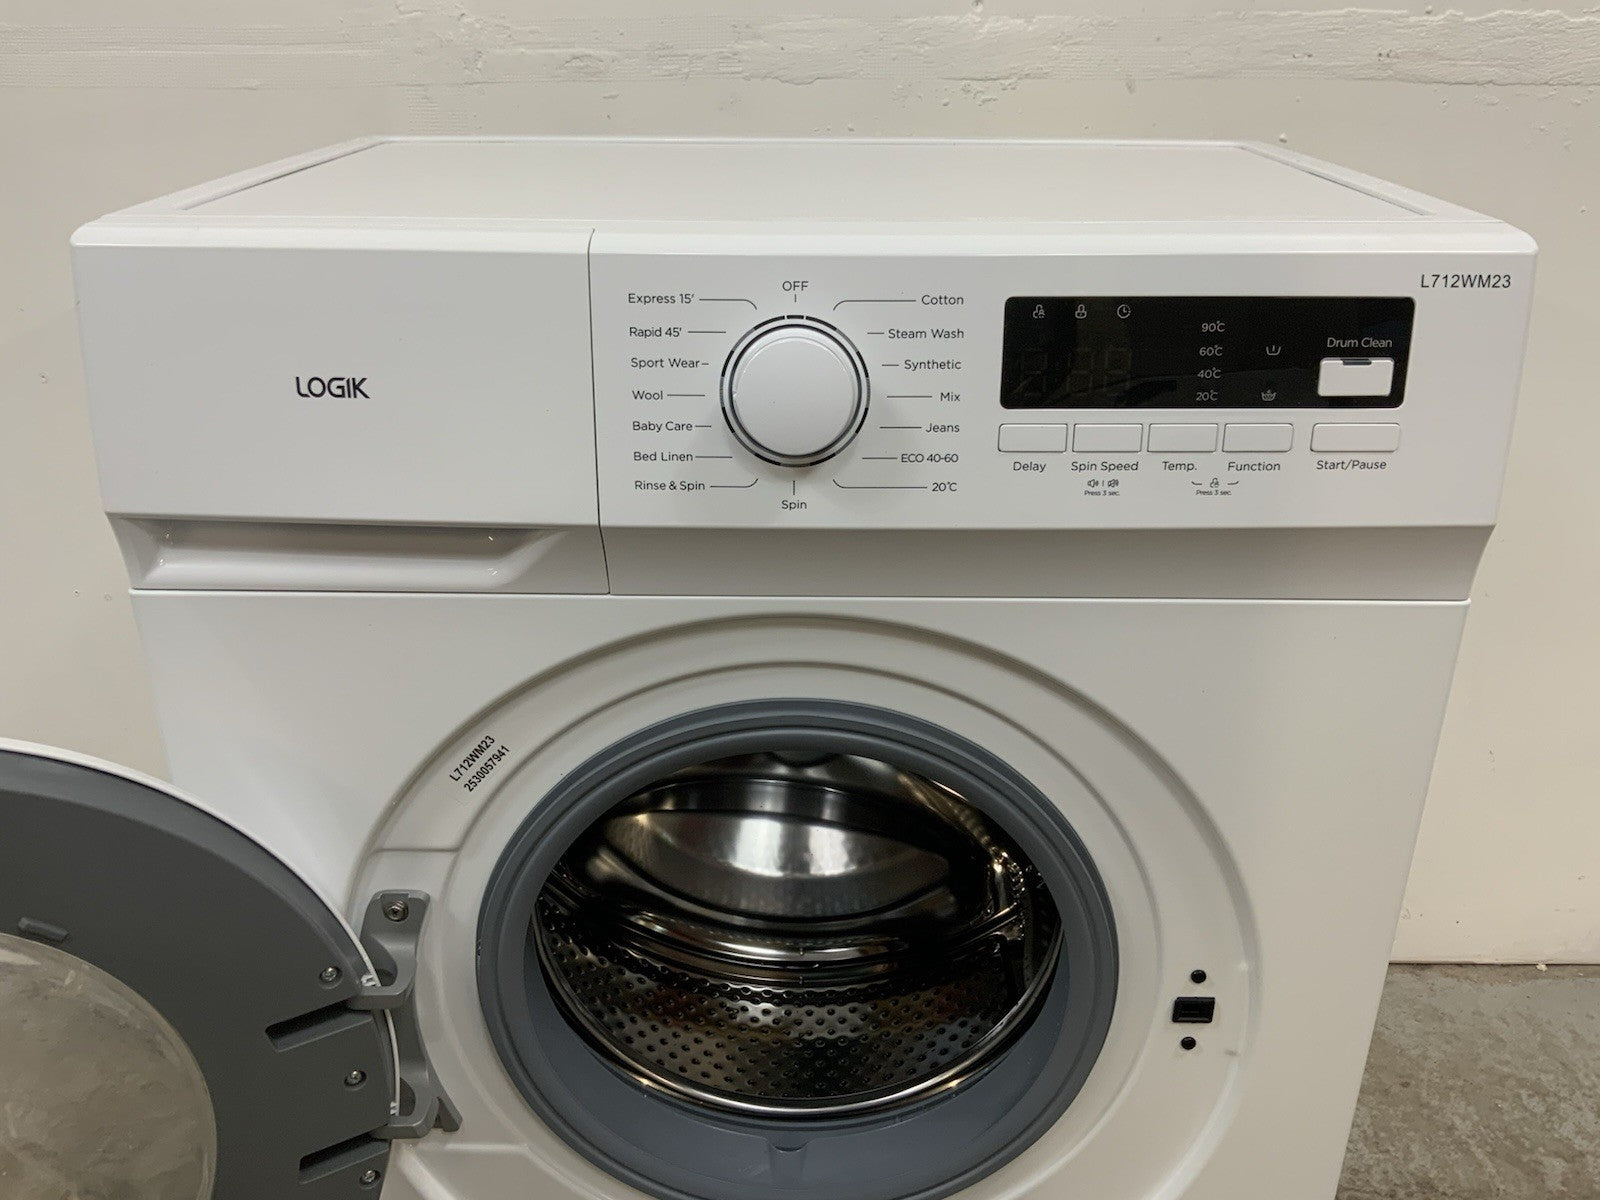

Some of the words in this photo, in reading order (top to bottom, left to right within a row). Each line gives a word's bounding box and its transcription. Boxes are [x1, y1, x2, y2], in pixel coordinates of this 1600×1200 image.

[782, 281, 808, 291] OFF
[1421, 274, 1511, 288] L712WM23
[628, 293, 676, 305] Express
[922, 295, 964, 305] Cotton
[630, 327, 662, 338] Rapid
[888, 329, 926, 339] Steam
[931, 329, 964, 338] Wash
[1327, 337, 1357, 347] Drum
[1361, 337, 1392, 348] Clean
[631, 358, 664, 369] Sport
[668, 358, 700, 368] Wear
[905, 359, 961, 371] Synthetic
[296, 377, 370, 399] LOGIK
[632, 391, 663, 400] Wool
[941, 392, 960, 401] Mix
[633, 421, 662, 433] Baby
[665, 421, 693, 431] Care
[926, 423, 959, 433] Jeans
[634, 451, 657, 461] Bed
[661, 452, 693, 461] Linen
[901, 453, 924, 463] ECO
[927, 454, 958, 463] 40-60
[1013, 461, 1046, 473] Delay
[1071, 461, 1097, 472] Spin
[1101, 461, 1139, 472] Speed
[1162, 461, 1197, 472] Temp.
[1228, 462, 1280, 471] Function
[1316, 459, 1386, 470] Start/Pause
[635, 480, 666, 490] Rinse
[669, 481, 677, 490] &
[680, 481, 705, 492] Spin
[781, 500, 807, 511] Spin
[449, 735, 495, 781] L712WM23
[464, 745, 510, 792] 2530057941
